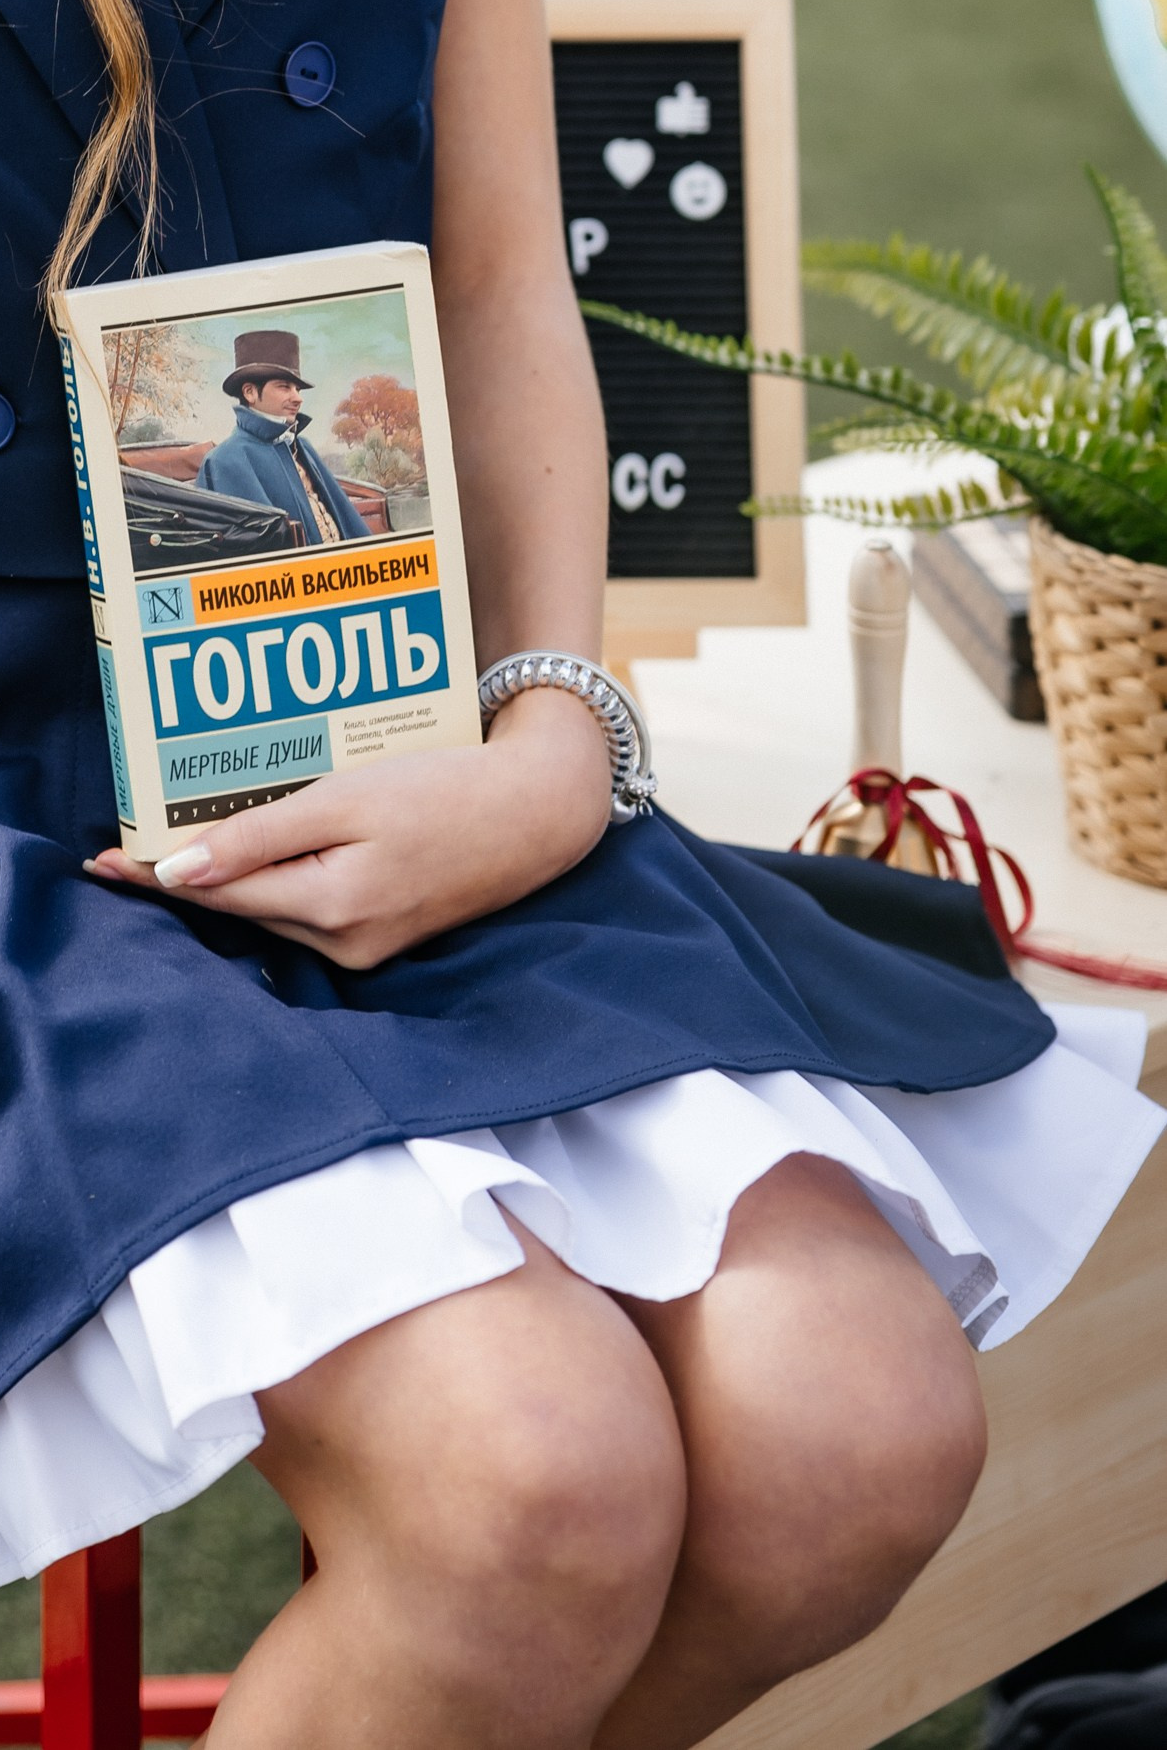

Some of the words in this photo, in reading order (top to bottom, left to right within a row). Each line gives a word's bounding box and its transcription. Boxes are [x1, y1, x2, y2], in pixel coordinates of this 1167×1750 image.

[62, 347, 88, 491] ГОГОЛЬ
[198, 572, 296, 612] НИКОЛАЙ
[301, 553, 430, 597] ВАСИЛЬЕВИЧ
[101, 657, 117, 719] ДУШИ
[152, 606, 441, 728] ГОГОЛЬ
[343, 720, 367, 731] Книги,
[368, 710, 415, 726] изменившие
[416, 707, 433, 718] мир.
[345, 730, 383, 744] Писатели,
[384, 719, 438, 735] объединившие
[107, 721, 128, 812] МЕРТВЫЕ
[169, 745, 260, 782] МЕРТВЫЕ
[265, 734, 323, 770] ДУШИ
[346, 742, 385, 757] поколения.
